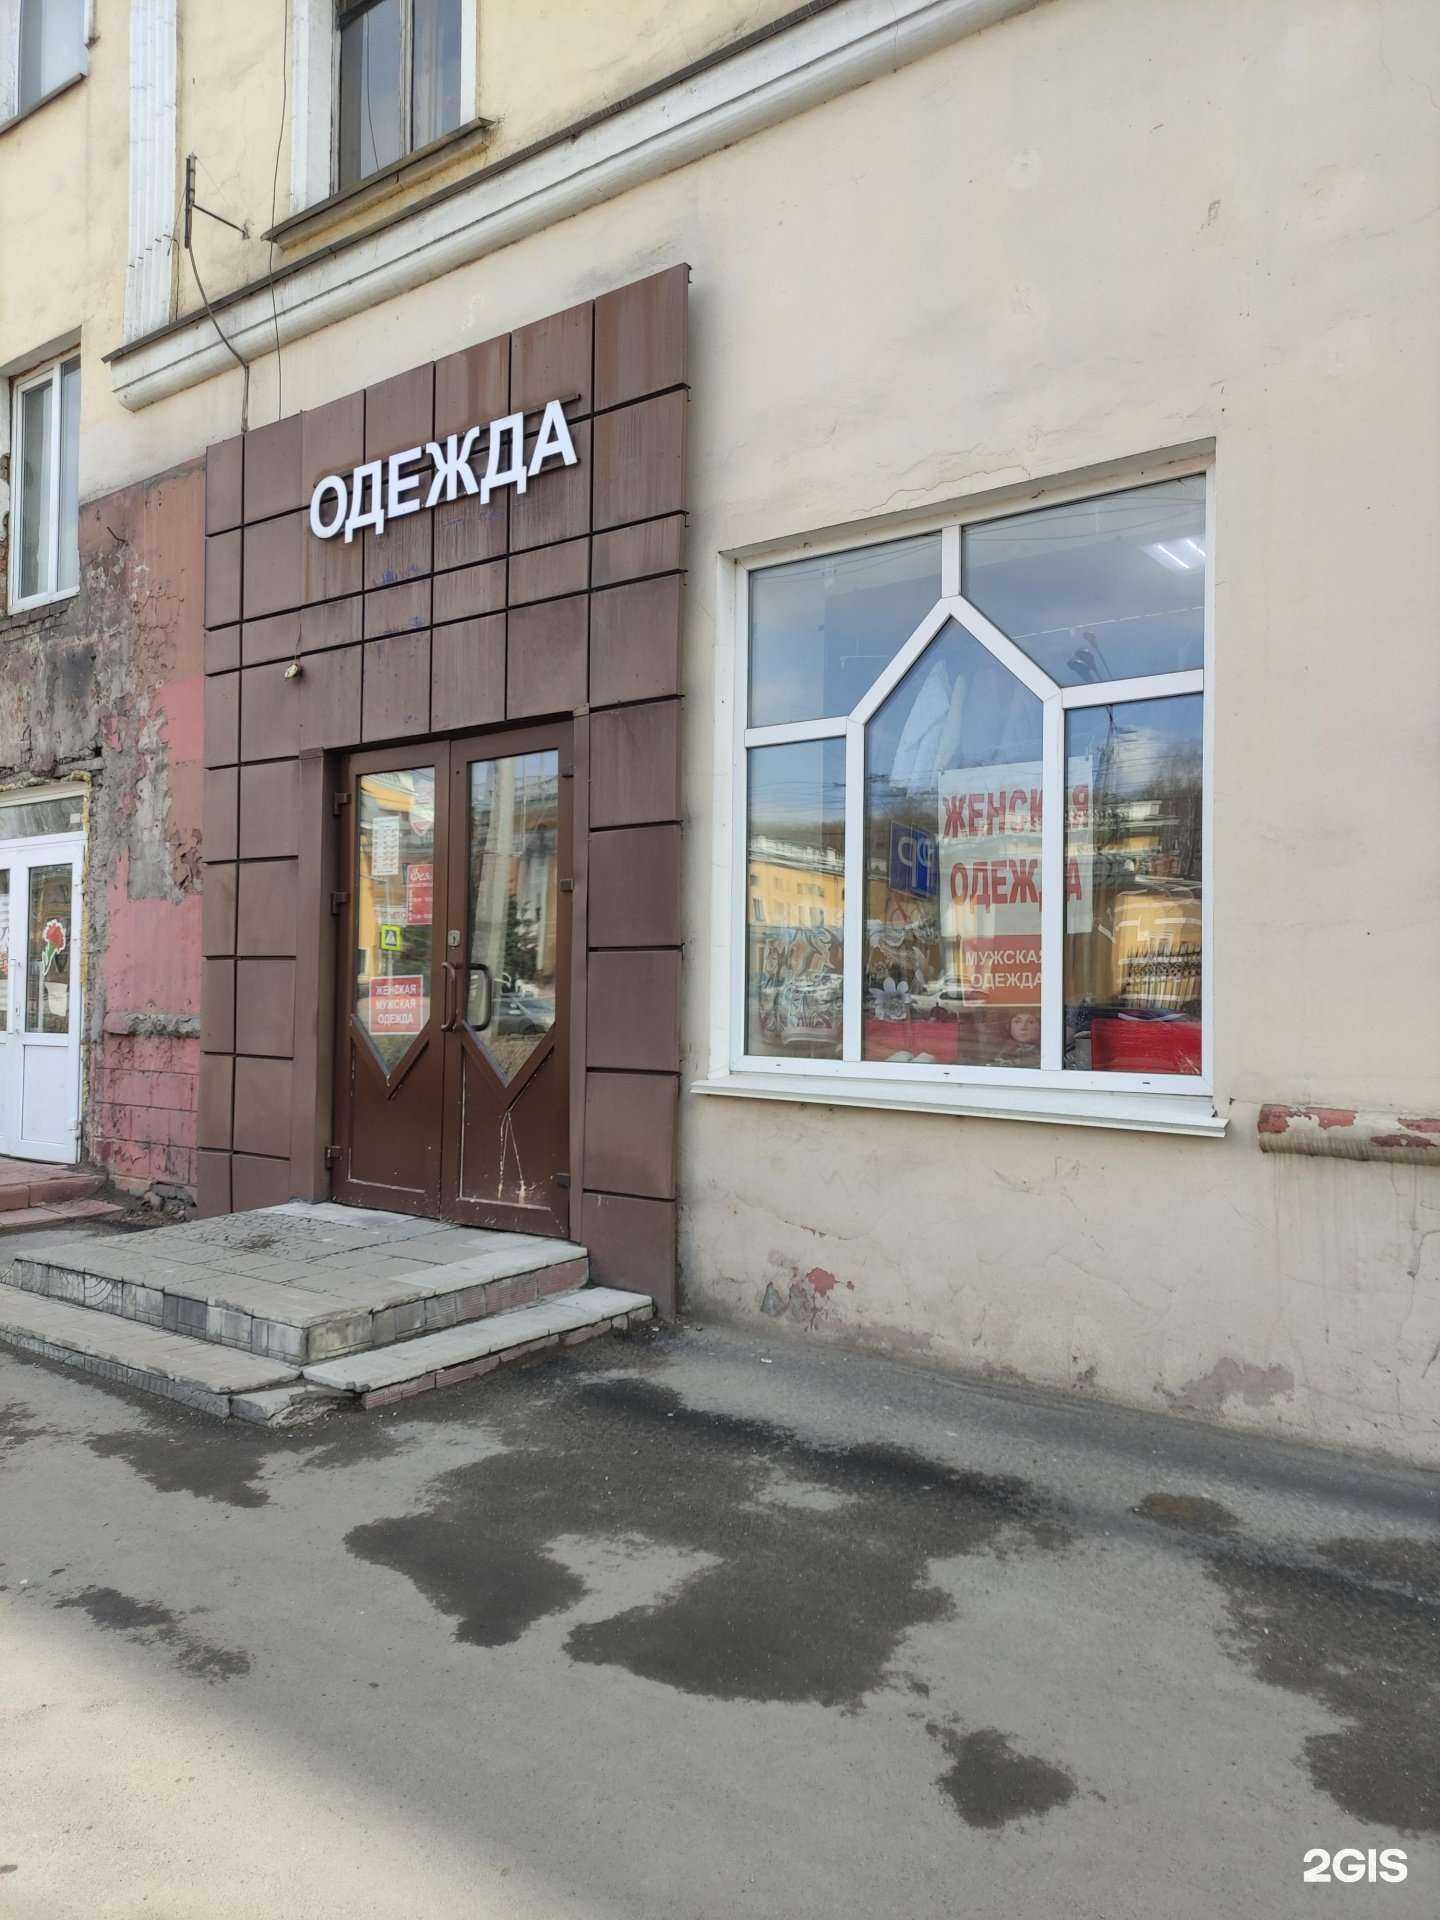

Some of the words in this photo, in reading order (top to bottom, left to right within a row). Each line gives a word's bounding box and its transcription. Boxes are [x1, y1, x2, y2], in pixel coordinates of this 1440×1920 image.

[309, 399, 578, 544] ОДЕЖДА
[943, 784, 1089, 838] ЖЕНСКЯ
[950, 857, 1083, 913] ОДЕЖА
[378, 1013, 416, 1026] ОДЕЖДА
